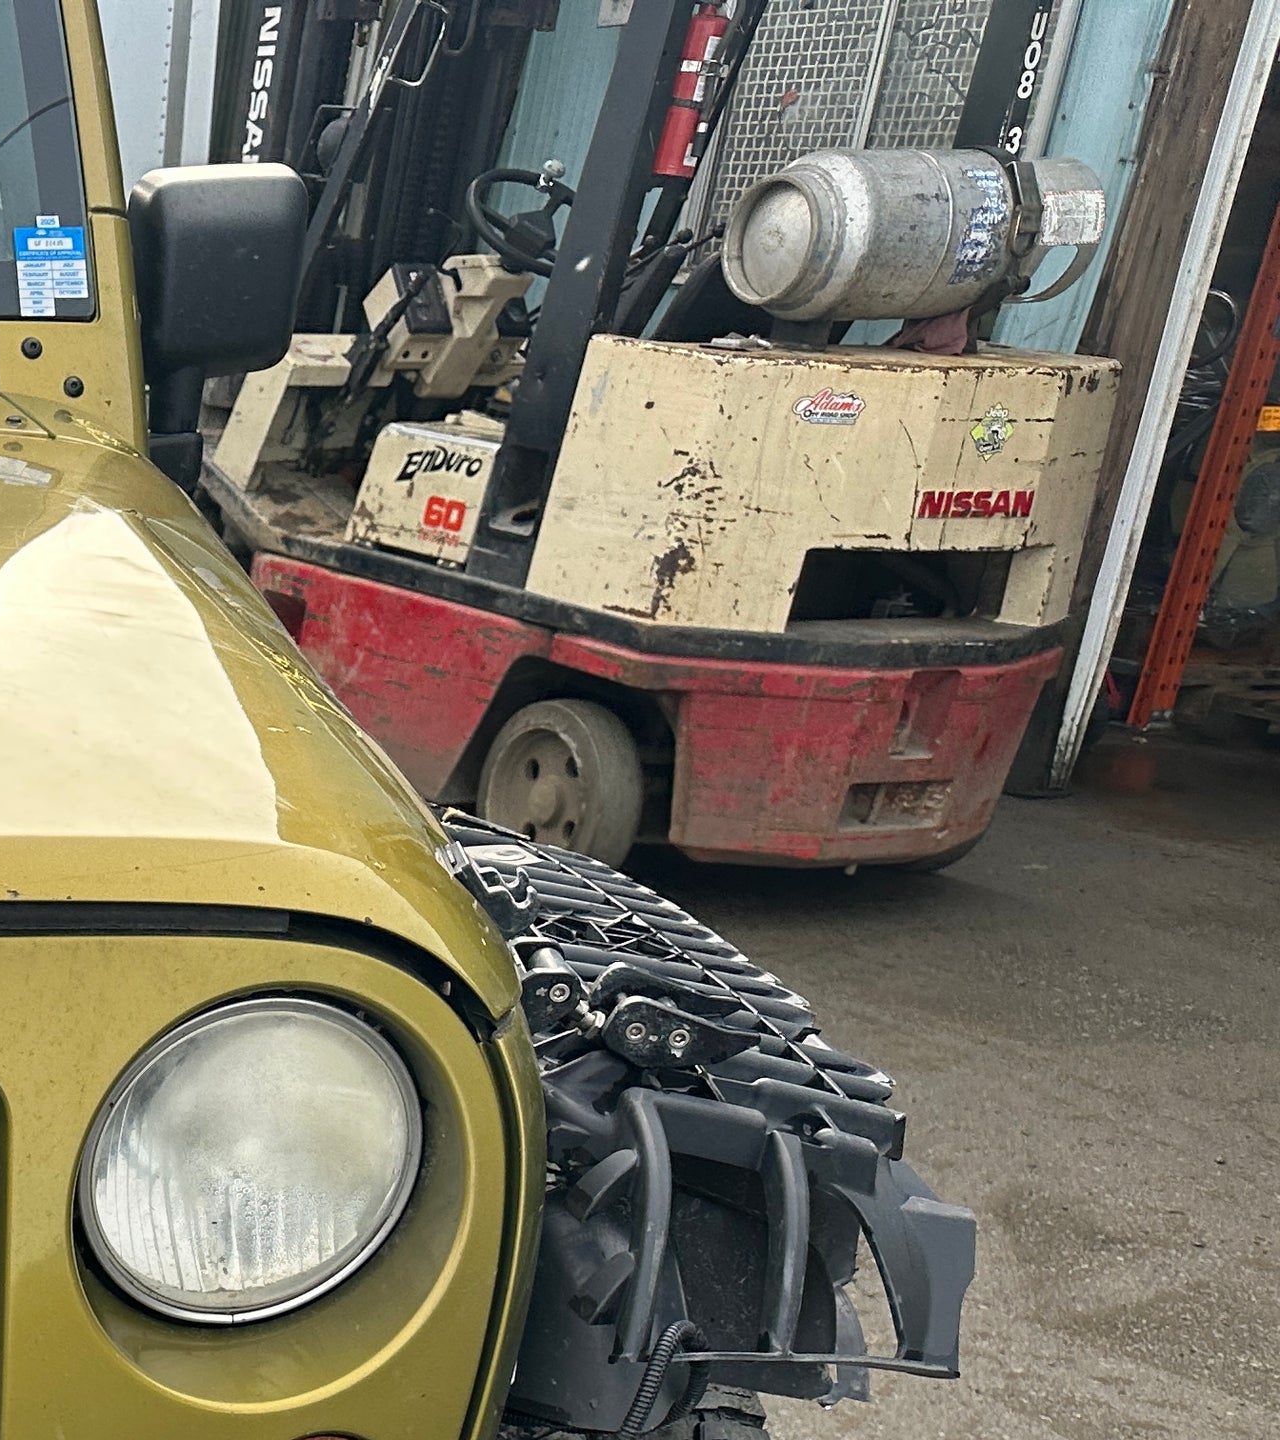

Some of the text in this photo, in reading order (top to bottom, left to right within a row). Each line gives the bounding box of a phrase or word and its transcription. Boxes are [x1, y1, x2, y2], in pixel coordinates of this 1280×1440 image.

[241, 6, 282, 163] NISSA
[985, 407, 1009, 418] Jeep
[423, 495, 467, 532] 60
[917, 490, 1035, 518] NISSAN
